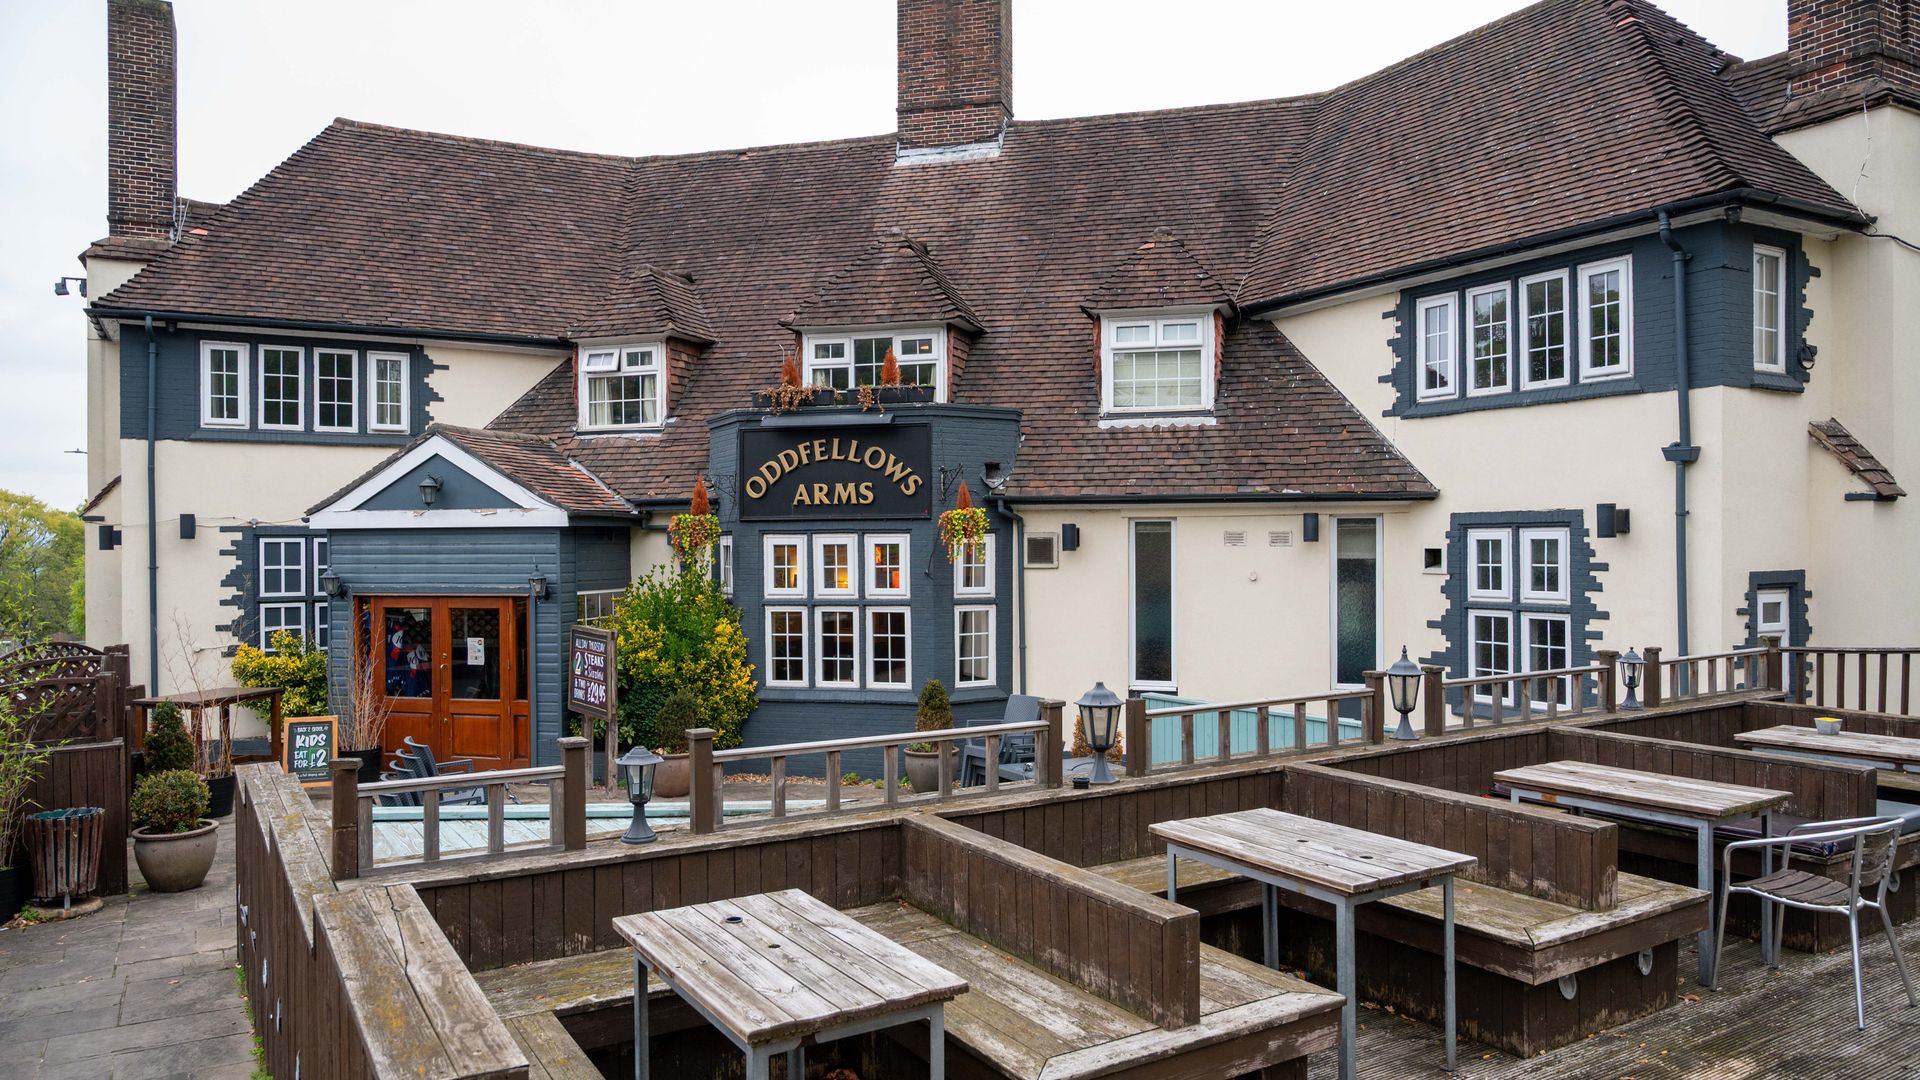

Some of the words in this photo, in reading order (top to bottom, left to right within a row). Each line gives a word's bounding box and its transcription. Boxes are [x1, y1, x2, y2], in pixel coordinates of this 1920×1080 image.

[745, 438, 923, 499] ODDFELLOWS
[793, 482, 874, 505] ARMS
[575, 652, 581, 675] 2
[584, 652, 604, 669] STEAKS
[296, 734, 326, 748] KIDS
[294, 751, 308, 759] EAT
[310, 749, 327, 767] £2
[294, 760, 309, 769] FOR
